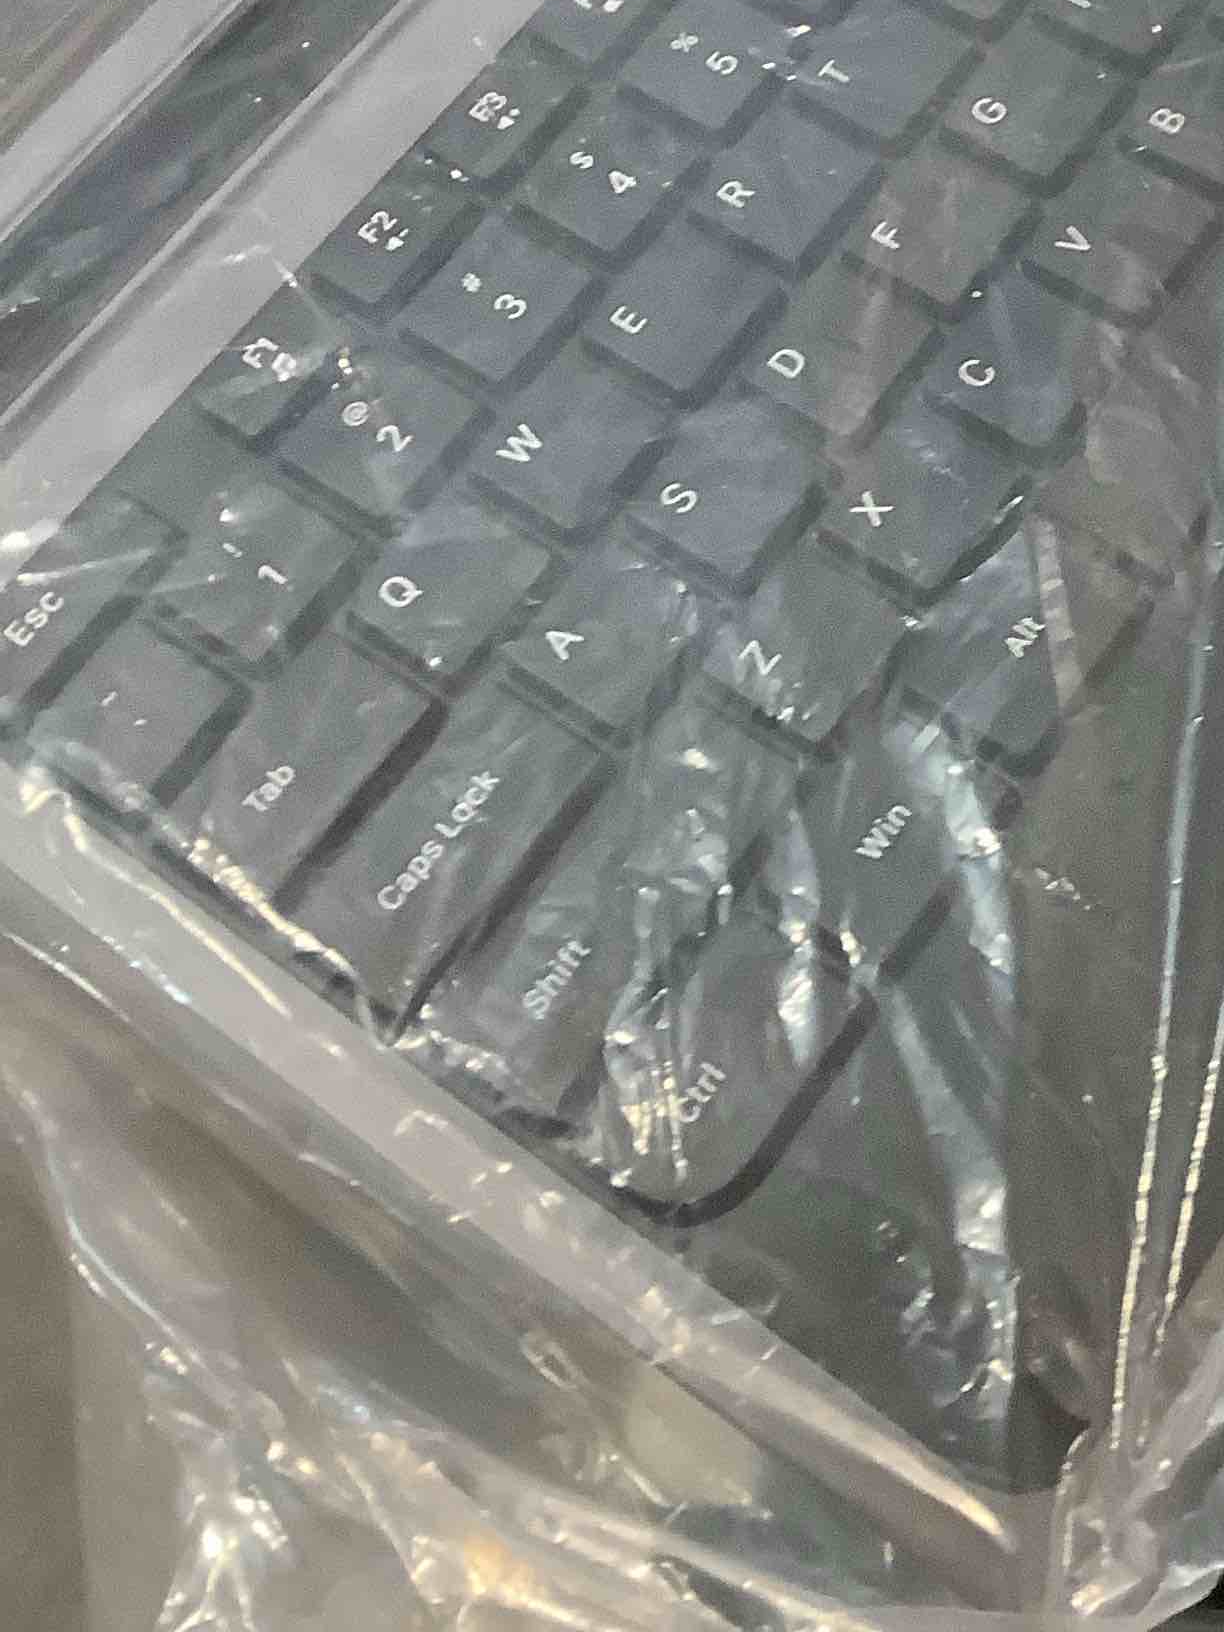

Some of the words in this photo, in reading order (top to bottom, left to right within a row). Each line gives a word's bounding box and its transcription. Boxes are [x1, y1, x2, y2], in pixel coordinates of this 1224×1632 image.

[706, 51, 737, 75] 5
[818, 60, 849, 82] T
[972, 97, 1007, 125] G
[1148, 108, 1185, 135] B
[607, 171, 637, 194] 4
[716, 179, 756, 209] R
[358, 211, 397, 243] F2
[871, 221, 901, 248] F
[1055, 225, 1091, 254] V
[494, 293, 527, 319] 3
[609, 305, 648, 334] E
[767, 348, 807, 379] D
[958, 359, 995, 387] C
[376, 426, 413, 451] 2
[496, 423, 543, 464] W
[661, 483, 697, 514] S
[849, 491, 894, 526] X
[258, 564, 289, 587] 1
[378, 576, 424, 608] Q
[4, 591, 64, 647] Esc
[545, 630, 585, 661] A
[1003, 617, 1046, 658] Alt
[737, 639, 782, 675] Z
[241, 766, 296, 813] Tab
[376, 839, 446, 910] Caps
[434, 771, 501, 838] Lock
[856, 805, 912, 859] Win
[523, 940, 591, 1019] Shift
